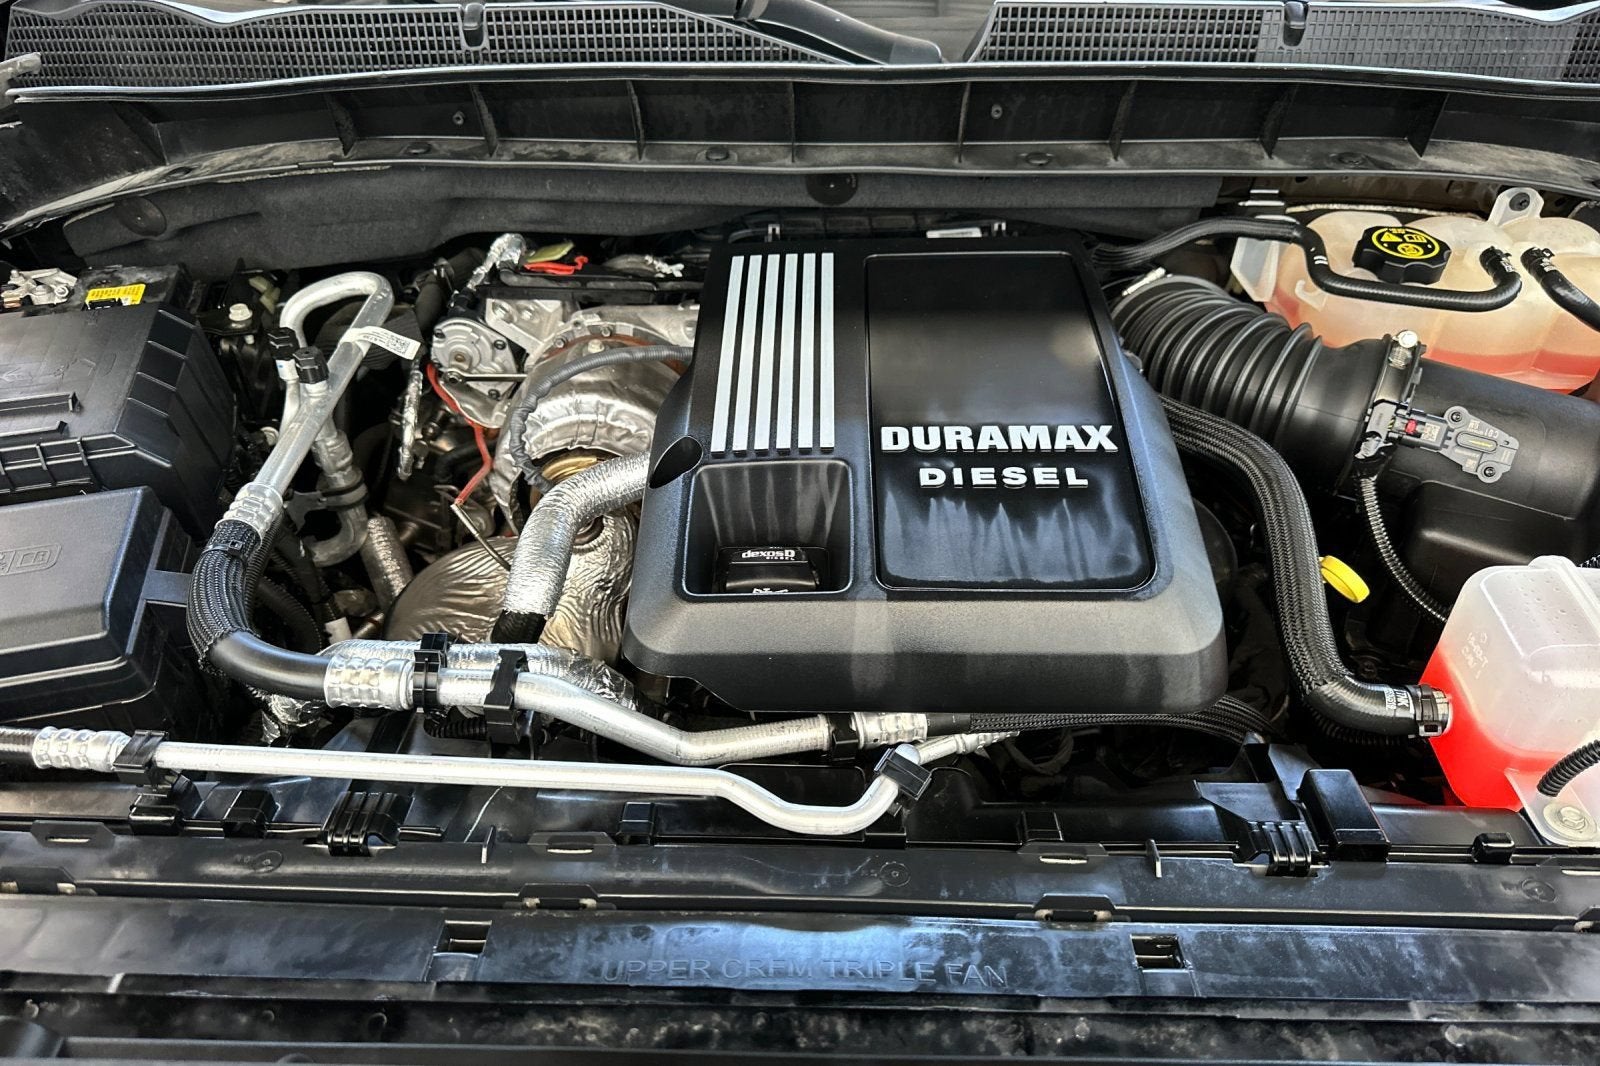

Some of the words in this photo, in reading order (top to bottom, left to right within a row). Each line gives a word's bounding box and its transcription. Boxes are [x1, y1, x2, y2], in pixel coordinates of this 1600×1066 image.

[880, 424, 1119, 452] DURAMAX
[918, 466, 1090, 488] DIESEL
[741, 549, 796, 559] dexosD
[601, 959, 712, 982] UPPER
[823, 960, 937, 983] TRIPLE
[944, 963, 1008, 988] FAN
